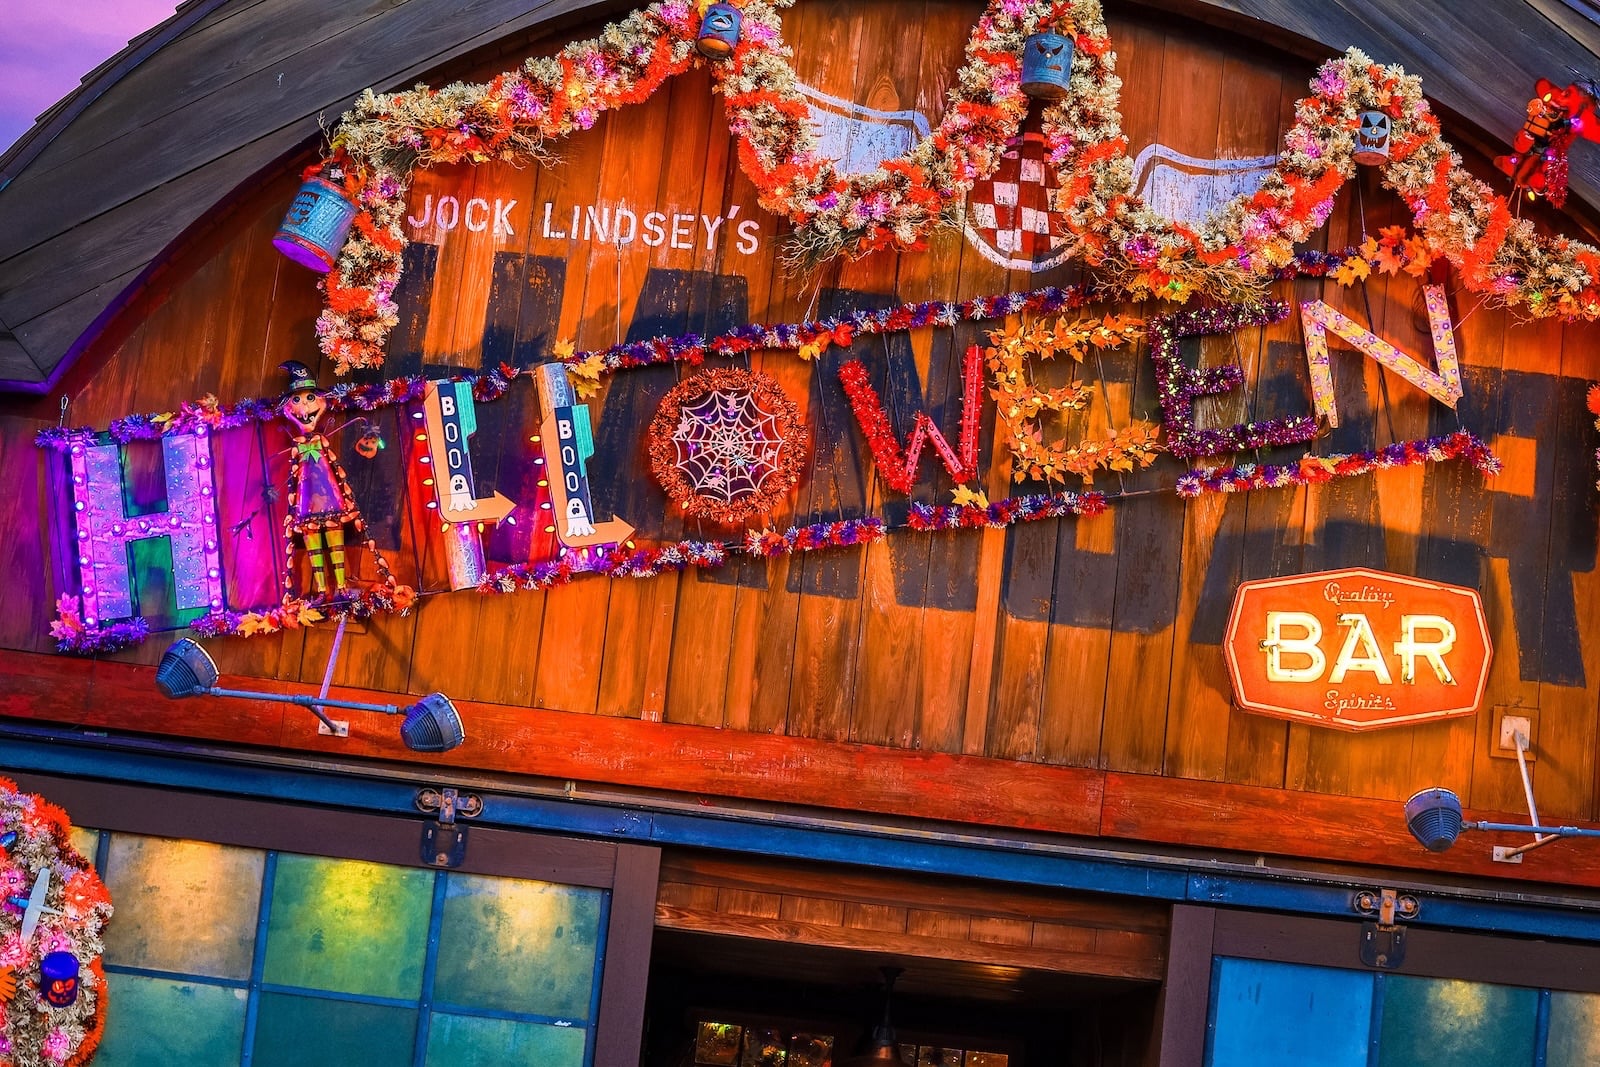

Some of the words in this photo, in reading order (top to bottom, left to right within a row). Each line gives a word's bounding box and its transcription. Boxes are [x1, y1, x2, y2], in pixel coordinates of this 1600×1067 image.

[407, 194, 518, 237] JOCK
[541, 199, 762, 256] LINDSEY'S
[441, 396, 463, 469] BOO
[558, 419, 580, 493] BOO
[1323, 581, 1396, 610] Quality
[1259, 610, 1458, 686] BAR
[1323, 689, 1398, 716] Spirits
